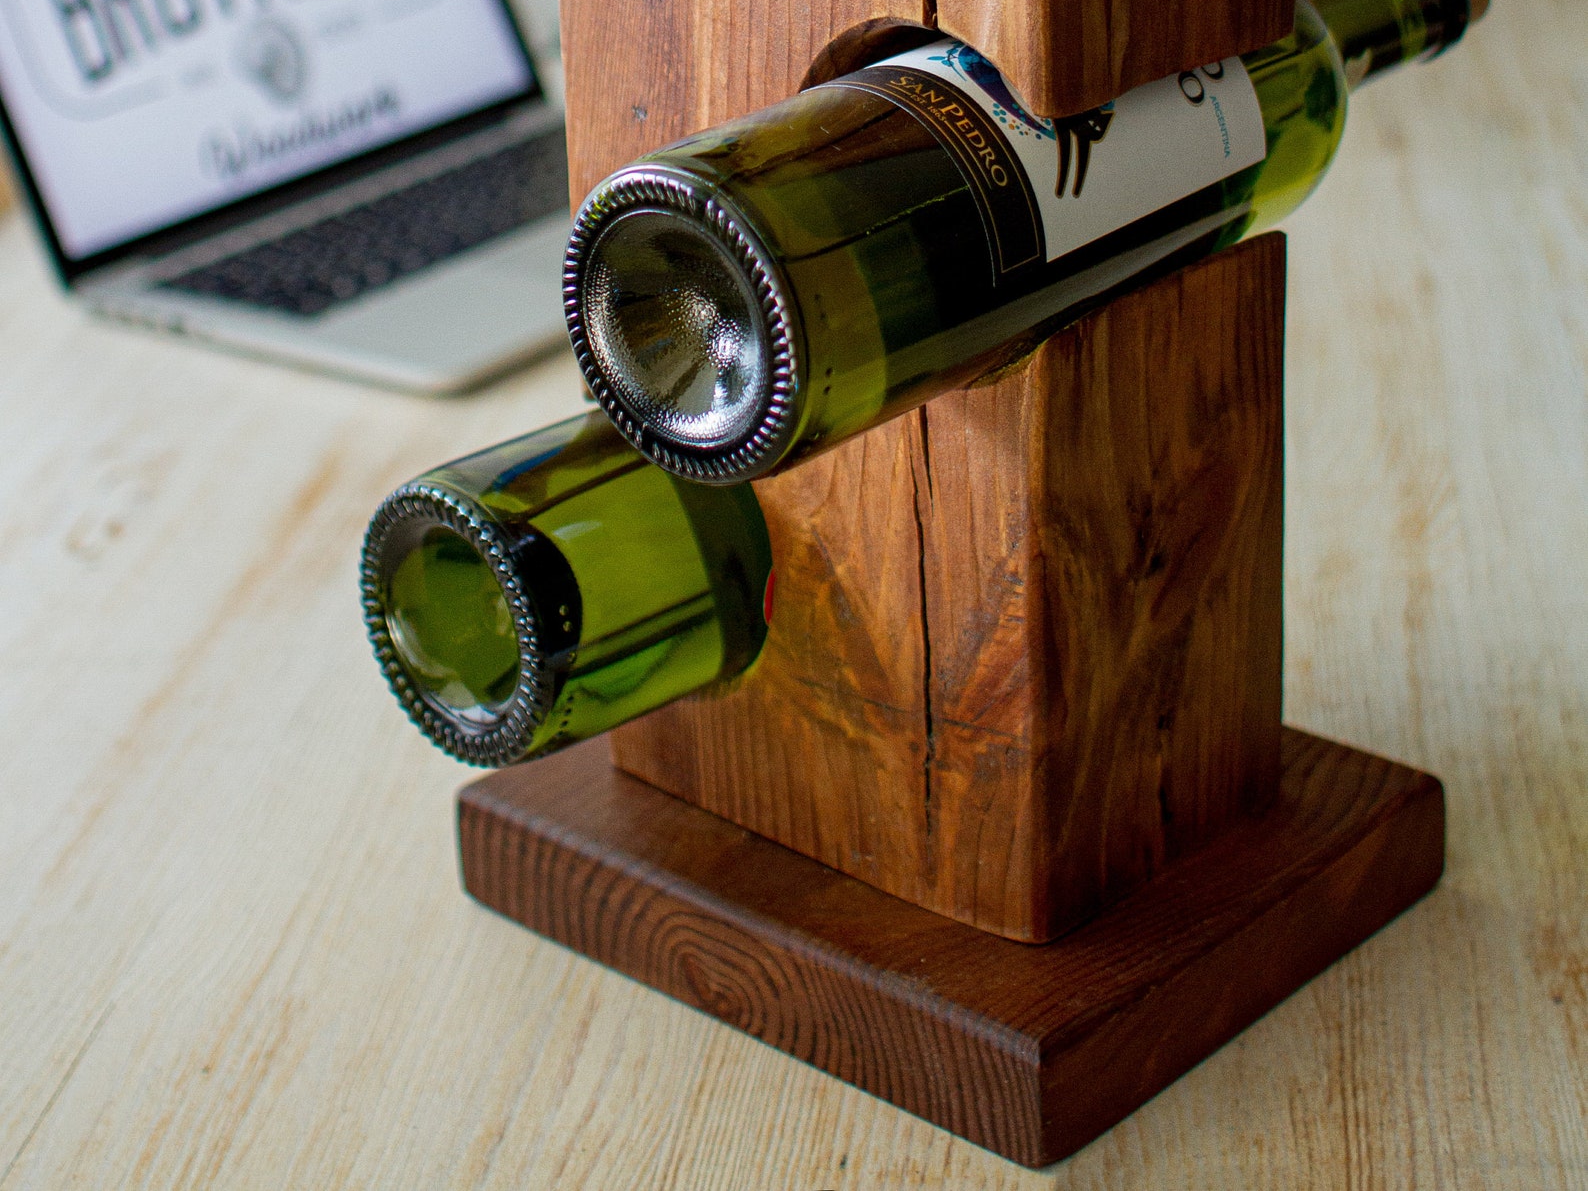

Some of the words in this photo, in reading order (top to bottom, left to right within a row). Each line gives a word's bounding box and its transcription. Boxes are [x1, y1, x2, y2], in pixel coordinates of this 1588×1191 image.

[890, 76, 944, 103] SAN
[940, 102, 1008, 187] PEDRO
[1209, 95, 1231, 158] ARGENTINA
